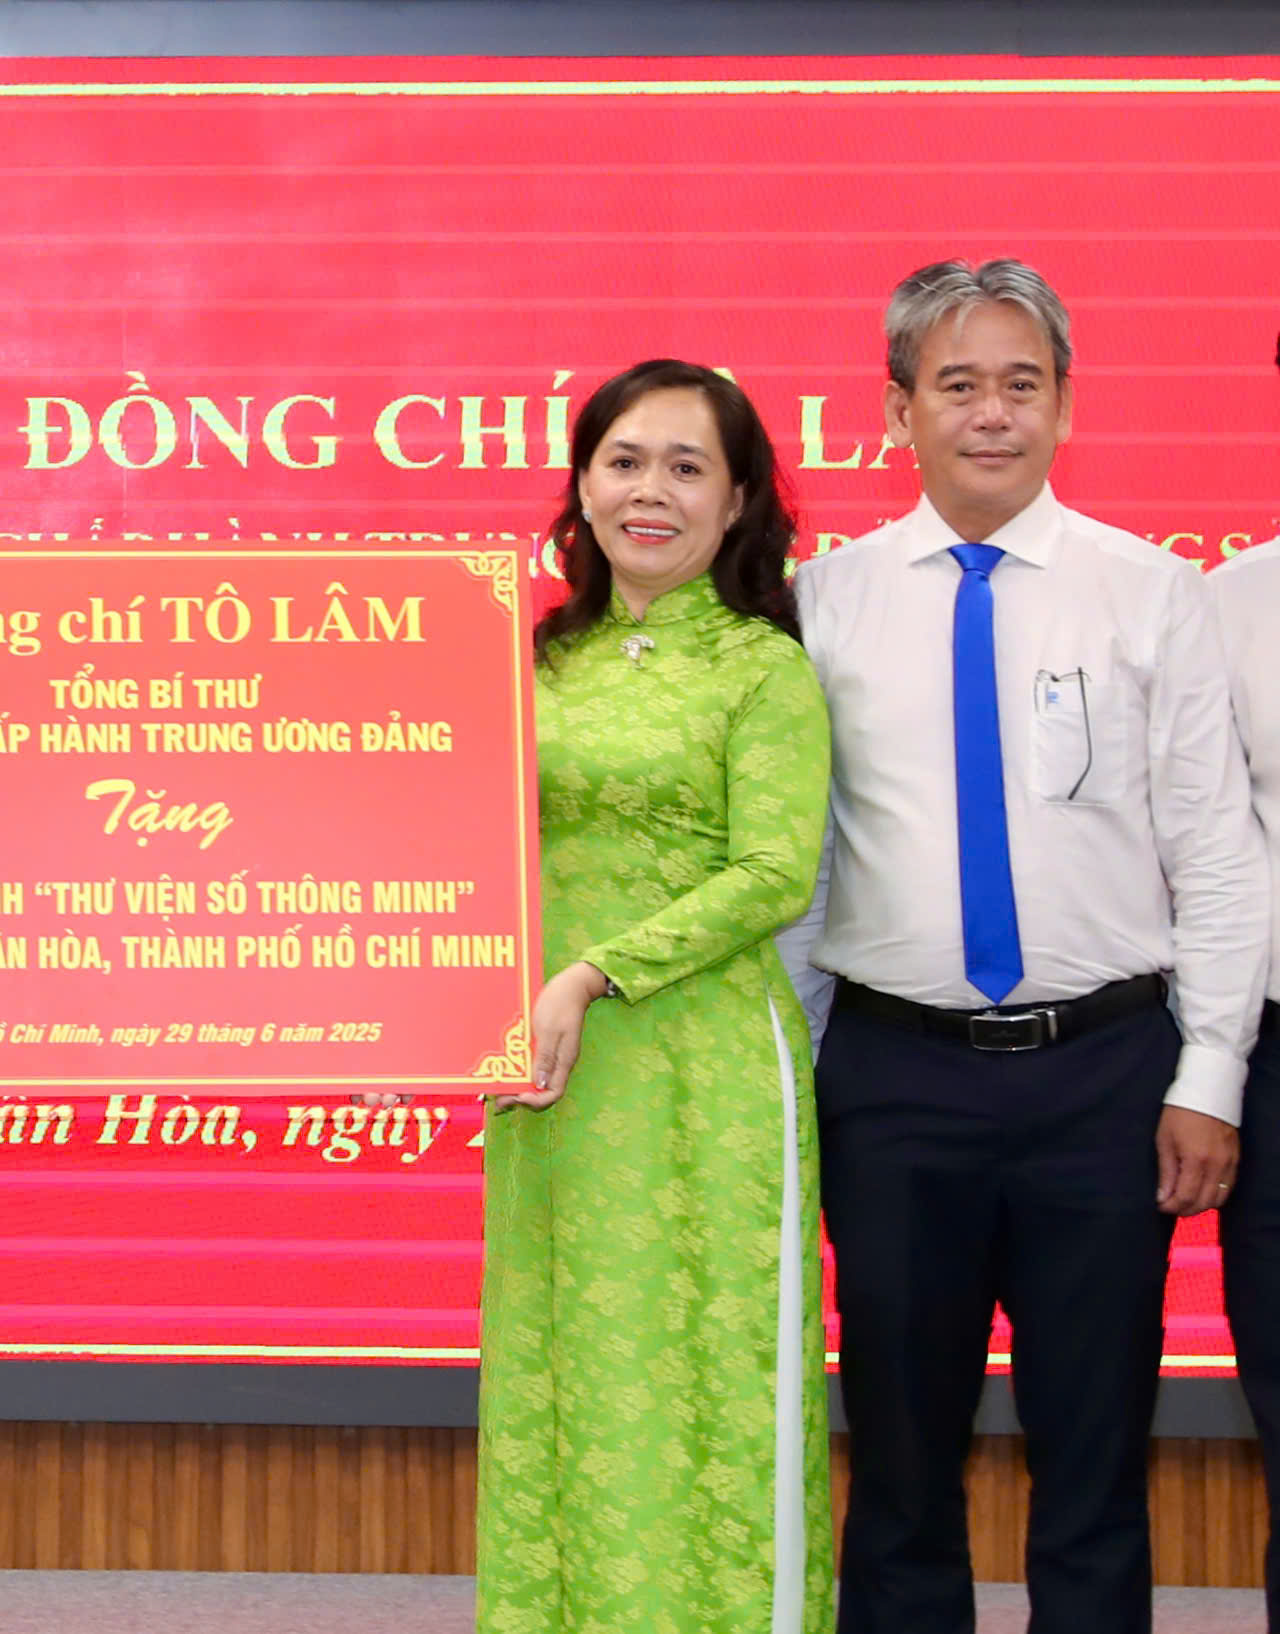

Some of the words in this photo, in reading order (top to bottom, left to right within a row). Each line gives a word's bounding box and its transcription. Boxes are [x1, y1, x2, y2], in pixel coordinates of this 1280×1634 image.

[17, 370, 343, 470] ĐỒNG
[373, 370, 576, 470] CHÍ
[58, 596, 145, 644] chí
[160, 583, 251, 643] TÔ
[270, 582, 425, 643] LÂM
[50, 664, 139, 710] TỔNG
[149, 672, 184, 709] BÍ
[193, 674, 263, 709] THƯ
[40, 716, 131, 753] HÀNH
[141, 722, 253, 753] TRUNG
[263, 716, 351, 752] ƯƠNG
[360, 711, 452, 753] ĐẢNG
[86, 779, 234, 850] Tặng
[125, 874, 196, 922] VIỆN
[206, 869, 249, 915] SỐ
[256, 874, 362, 915] THÔNG
[38, 929, 112, 975] HÒA,
[121, 929, 226, 969] THÀNH
[237, 924, 303, 969] PHỐ
[311, 924, 356, 969] HỒ
[366, 928, 421, 969] CHÍ
[431, 935, 516, 968] MINH
[9, 1023, 47, 1044] Chí
[48, 1023, 105, 1046] Minh,
[110, 1023, 161, 1047] ngày
[164, 1023, 194, 1043] 29
[197, 1023, 257, 1047] tháng
[260, 1023, 277, 1042] 6
[279, 1023, 325, 1042] năm
[328, 1022, 383, 1042] 2025
[96, 1094, 258, 1153] Hòa,
[281, 1096, 449, 1164] ngày
